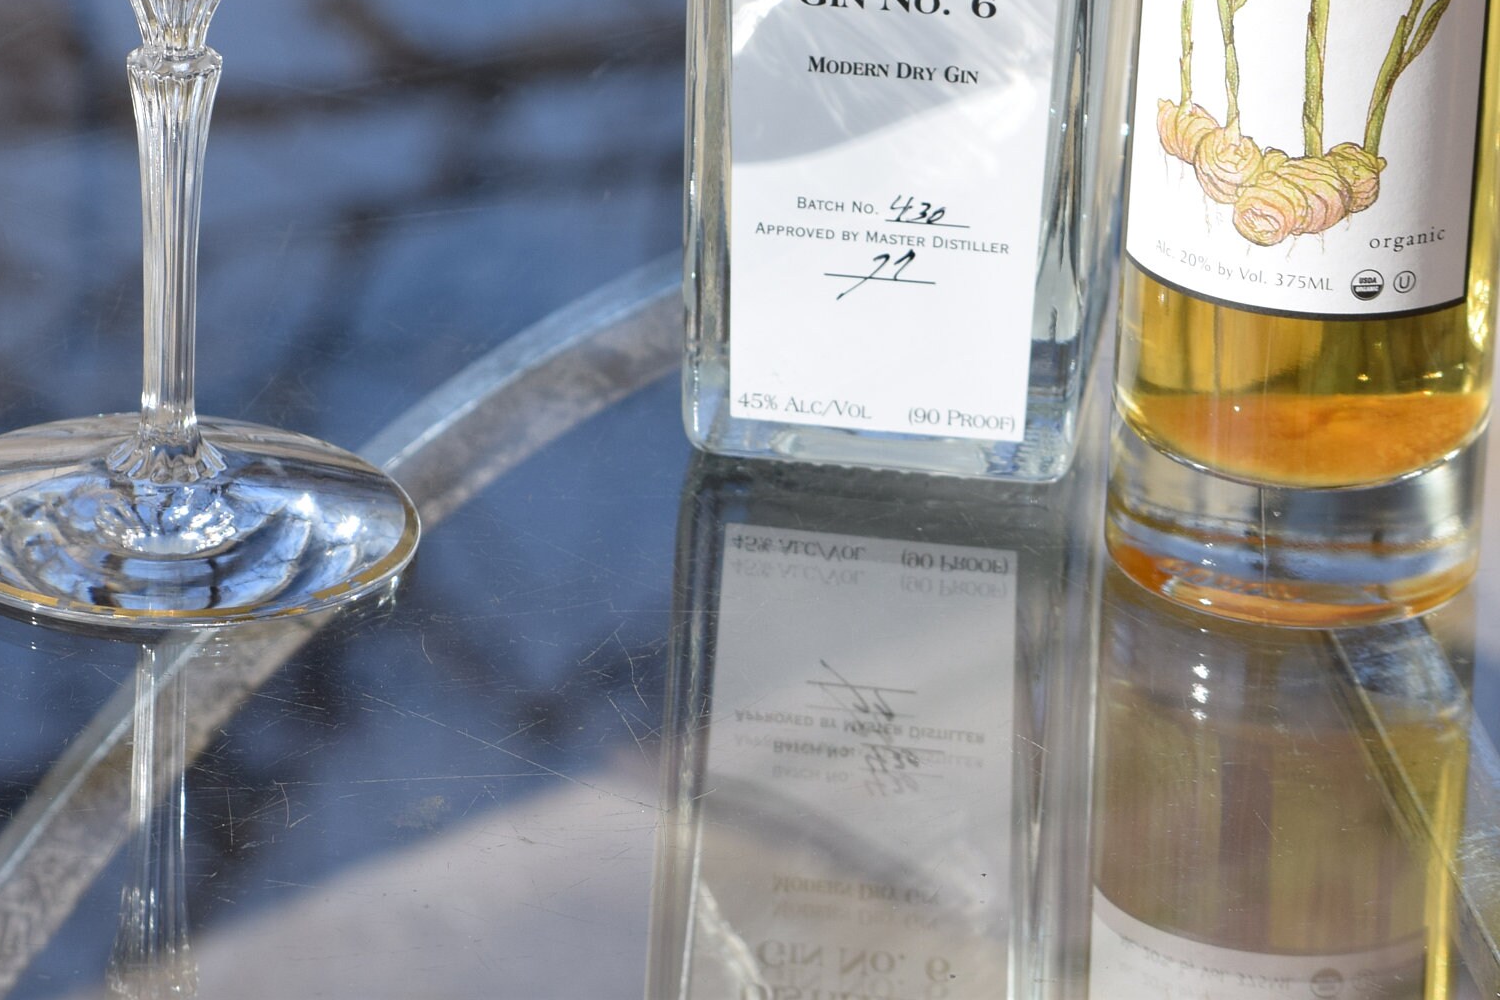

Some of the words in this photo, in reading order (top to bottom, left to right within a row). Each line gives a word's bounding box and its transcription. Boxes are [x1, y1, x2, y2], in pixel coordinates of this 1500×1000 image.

[807, 56, 890, 77] MODERN
[896, 62, 937, 80] DRY
[944, 66, 979, 83] GIN
[796, 197, 845, 212] BATCH
[852, 201, 879, 214] NO.
[889, 195, 947, 224] 430
[755, 223, 835, 239] APPROVED
[842, 230, 860, 242] BY
[866, 232, 926, 248] MASTER
[932, 237, 1009, 254] DISTILLER
[1369, 228, 1447, 253] organic
[1180, 251, 1211, 271] 20%
[1218, 262, 1234, 280] by
[1239, 268, 1268, 285] Vol.
[1275, 274, 1334, 292] 375ML
[737, 393, 778, 410] 45%
[784, 396, 873, 419] ALC/VOL
[908, 408, 941, 425] (90
[946, 409, 1016, 431] PROOF)
